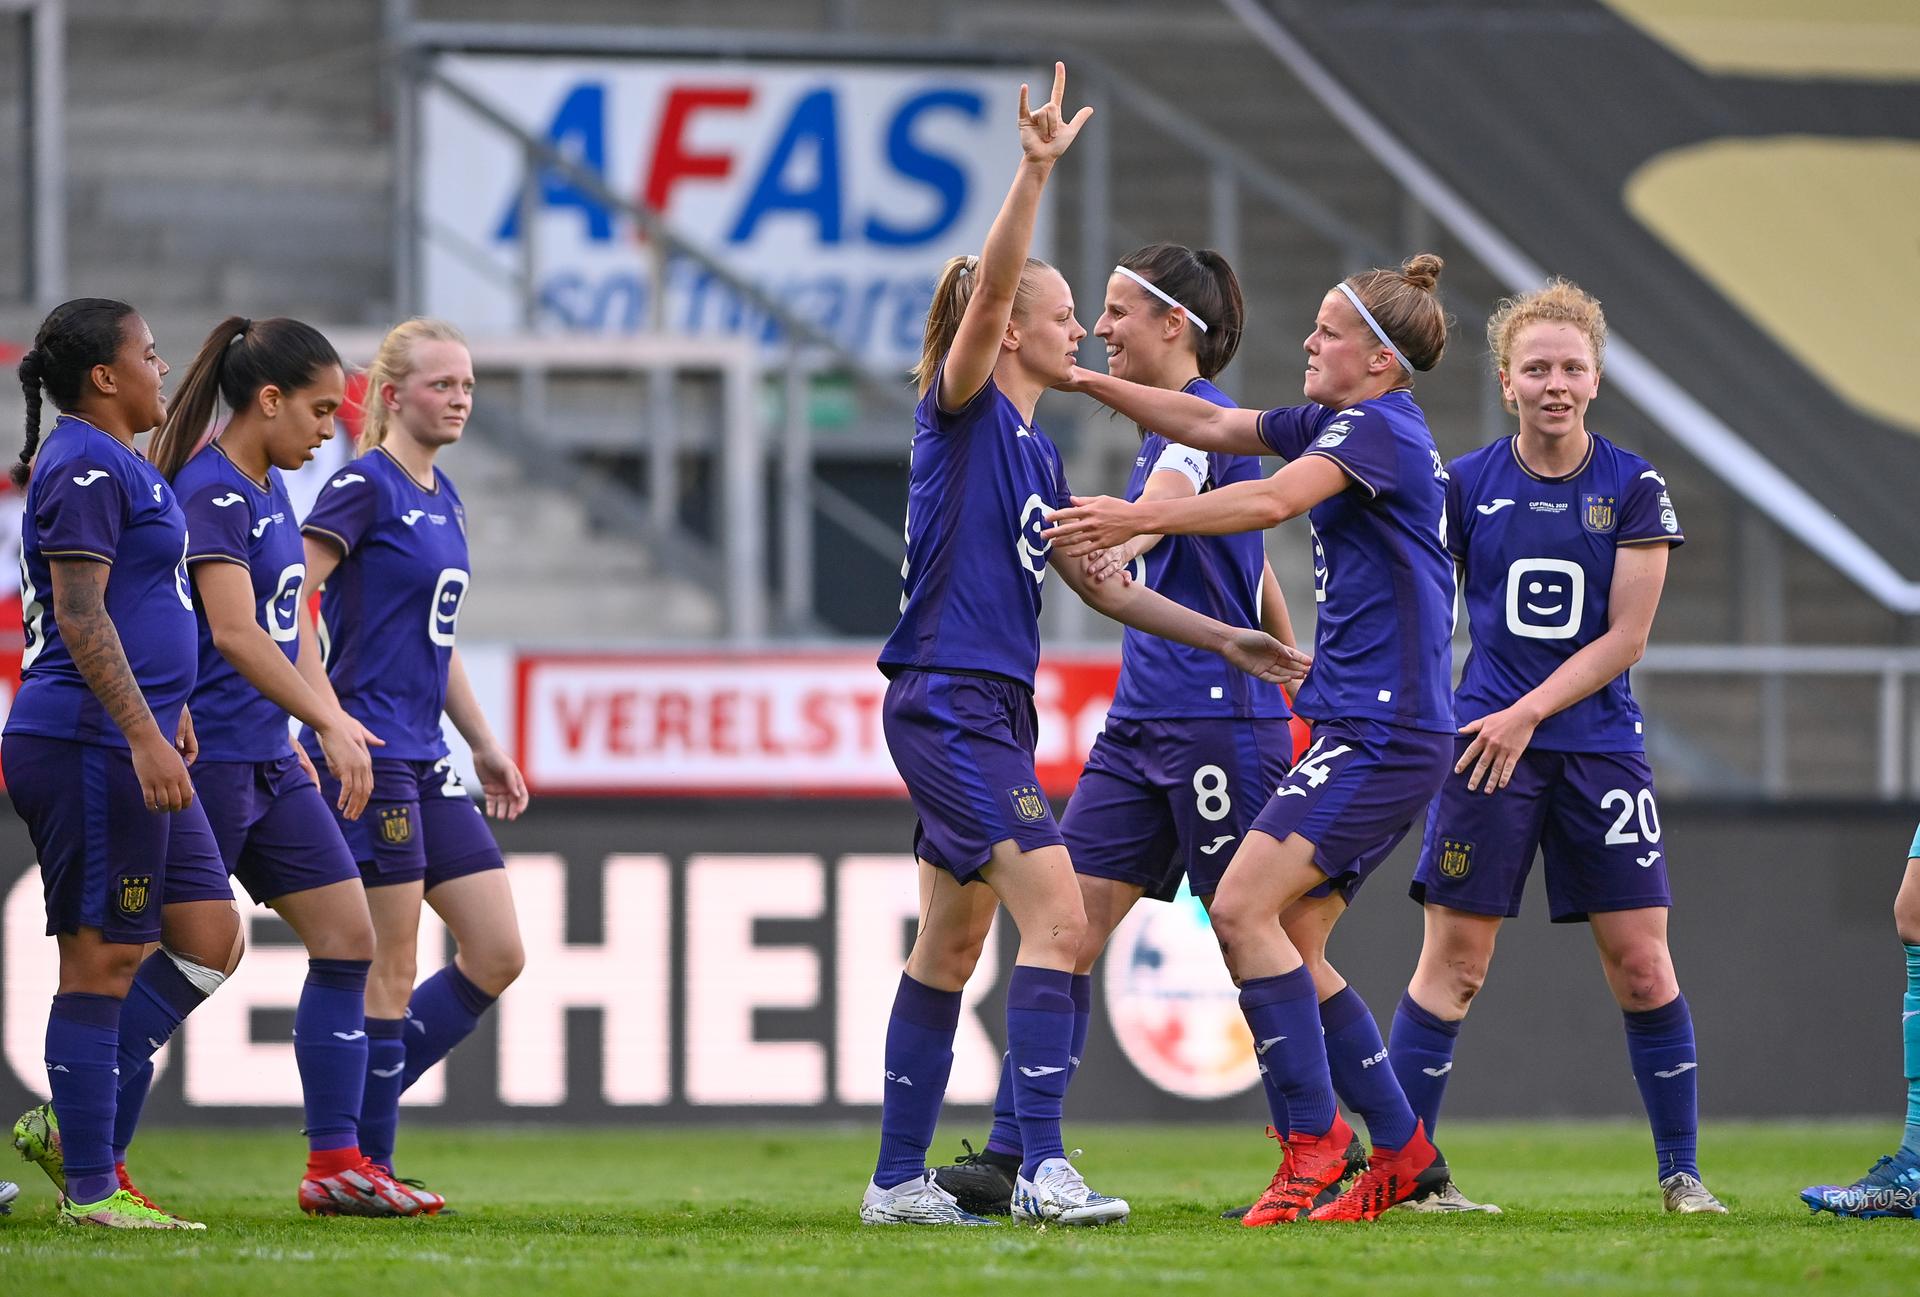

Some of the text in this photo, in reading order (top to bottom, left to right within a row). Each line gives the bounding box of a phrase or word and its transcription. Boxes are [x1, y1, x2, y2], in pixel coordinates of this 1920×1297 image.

[497, 79, 988, 248] AFAS
[1184, 456, 1205, 487] RSC
[554, 688, 881, 758] VERELST
[1193, 764, 1231, 821] 8
[1601, 788, 1661, 845] 20
